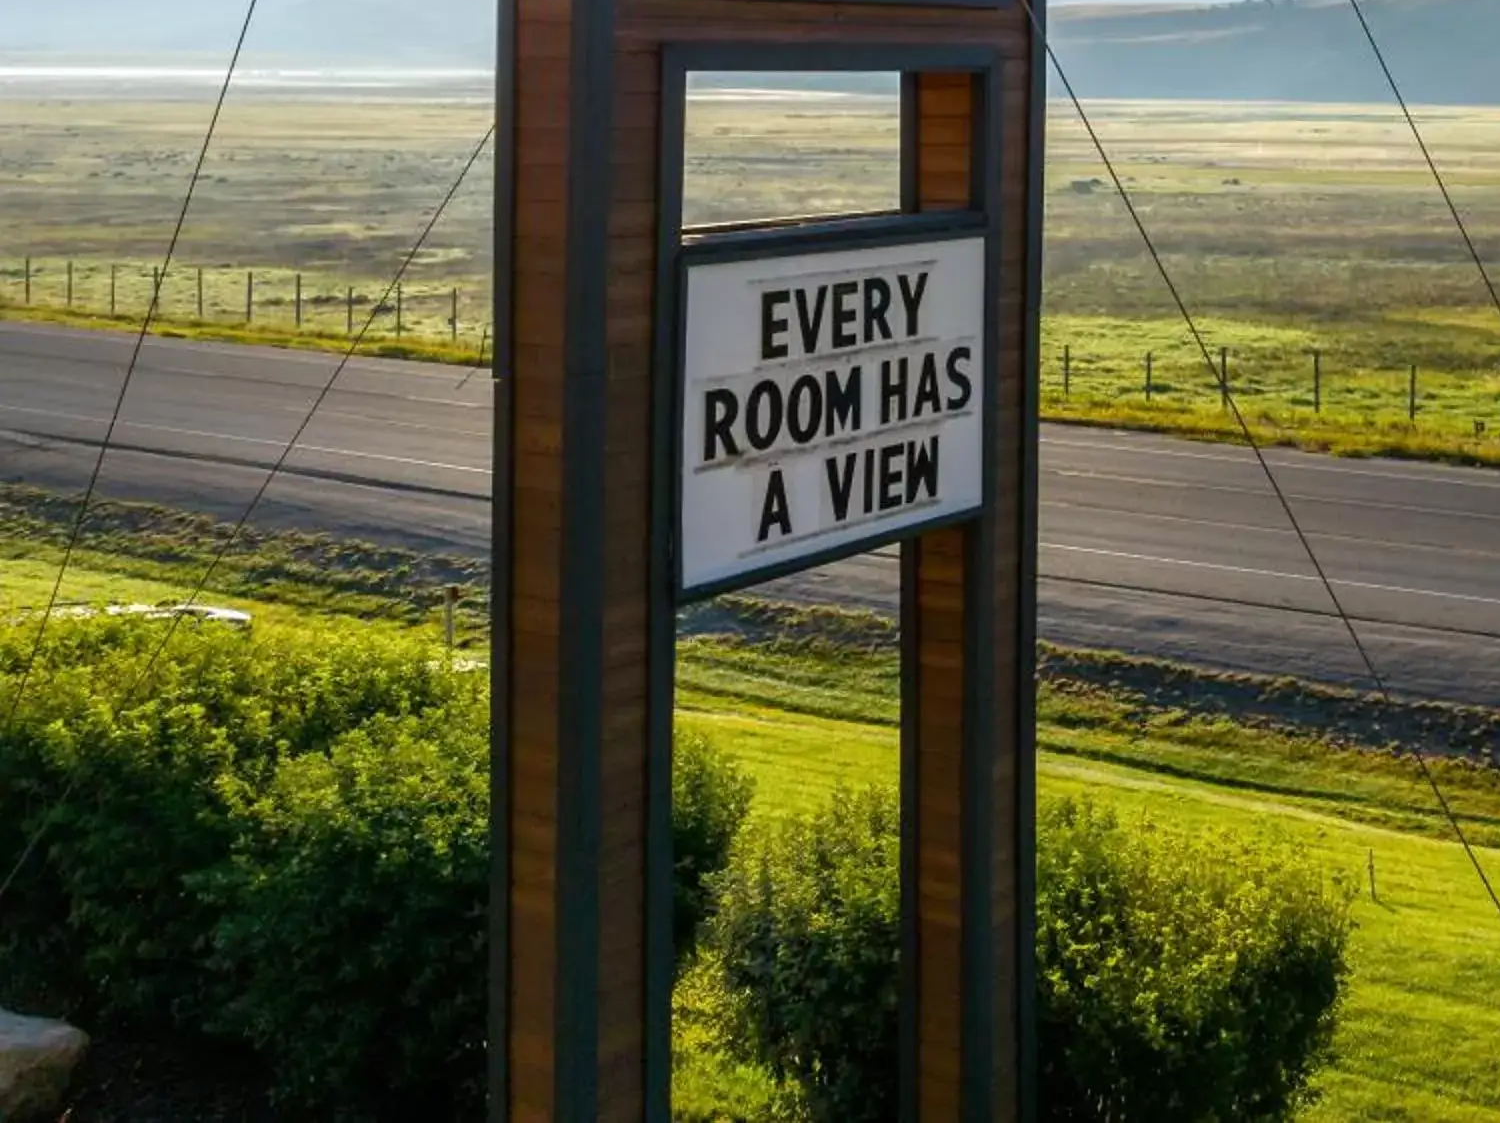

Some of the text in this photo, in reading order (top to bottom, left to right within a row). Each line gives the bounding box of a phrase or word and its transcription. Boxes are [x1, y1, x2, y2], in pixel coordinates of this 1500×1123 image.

[761, 273, 928, 360] EVERY
[703, 347, 972, 461] ROOM HAS
[757, 435, 939, 542] A VIEW
